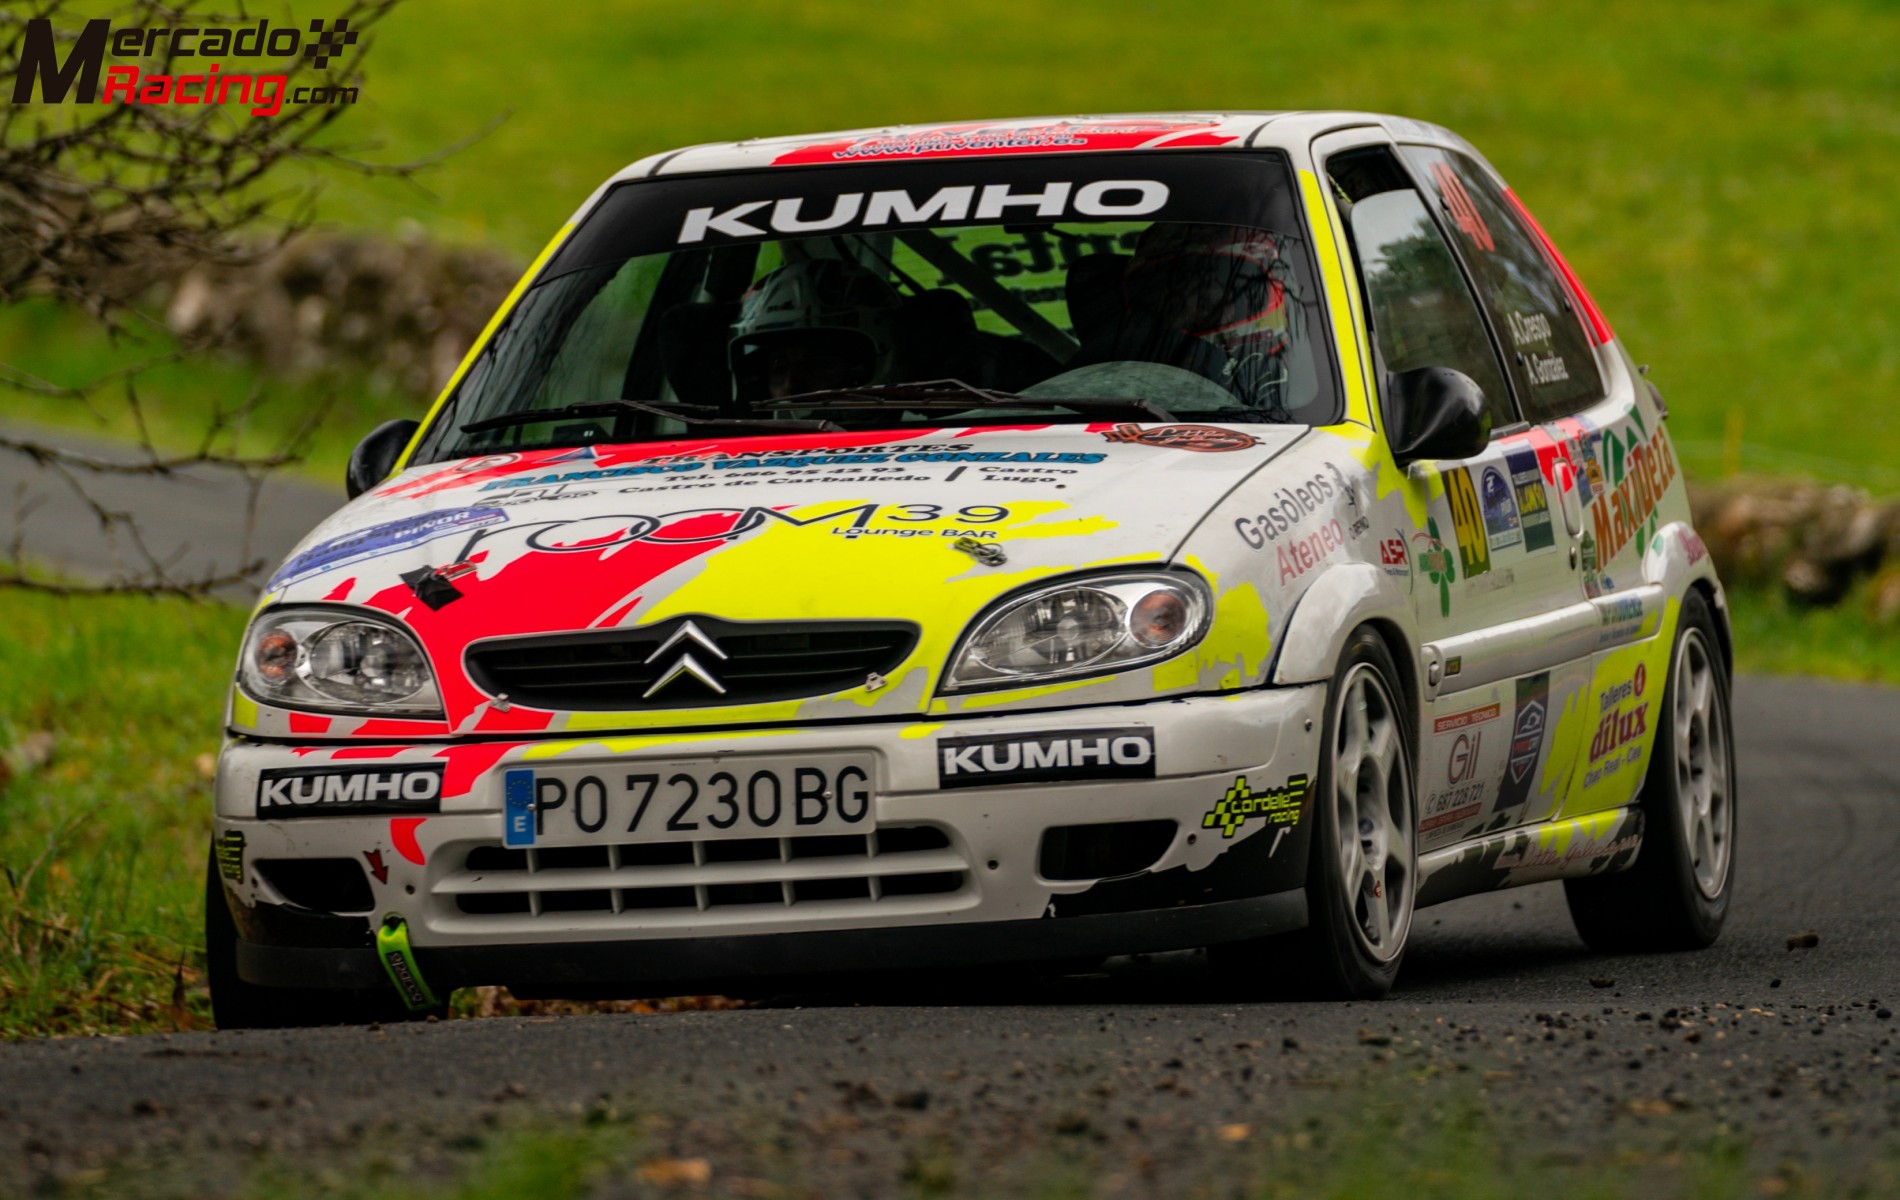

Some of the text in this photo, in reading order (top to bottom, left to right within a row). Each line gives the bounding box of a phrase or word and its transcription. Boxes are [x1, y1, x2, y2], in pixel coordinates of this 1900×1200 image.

[677, 180, 1170, 245] KUMHO
[478, 461, 705, 492] FRANCISCO
[712, 453, 888, 470] VAZQUEZ
[643, 443, 974, 465] TRANSPORTES
[978, 466, 1079, 475] Castro
[617, 474, 932, 493] Castro de Carballedo
[832, 527, 998, 539] Lounge BAR
[1447, 464, 1487, 567] 40
[1275, 518, 1344, 587] Ateneo
[1600, 680, 1632, 715] Talleres
[1588, 701, 1648, 766] dilux
[943, 736, 1152, 775] KUMHO
[1447, 731, 1482, 786] Gil
[259, 771, 441, 807] KUMHO
[626, 769, 782, 833] 7230
[795, 765, 870, 827] BG
[513, 816, 527, 833] E
